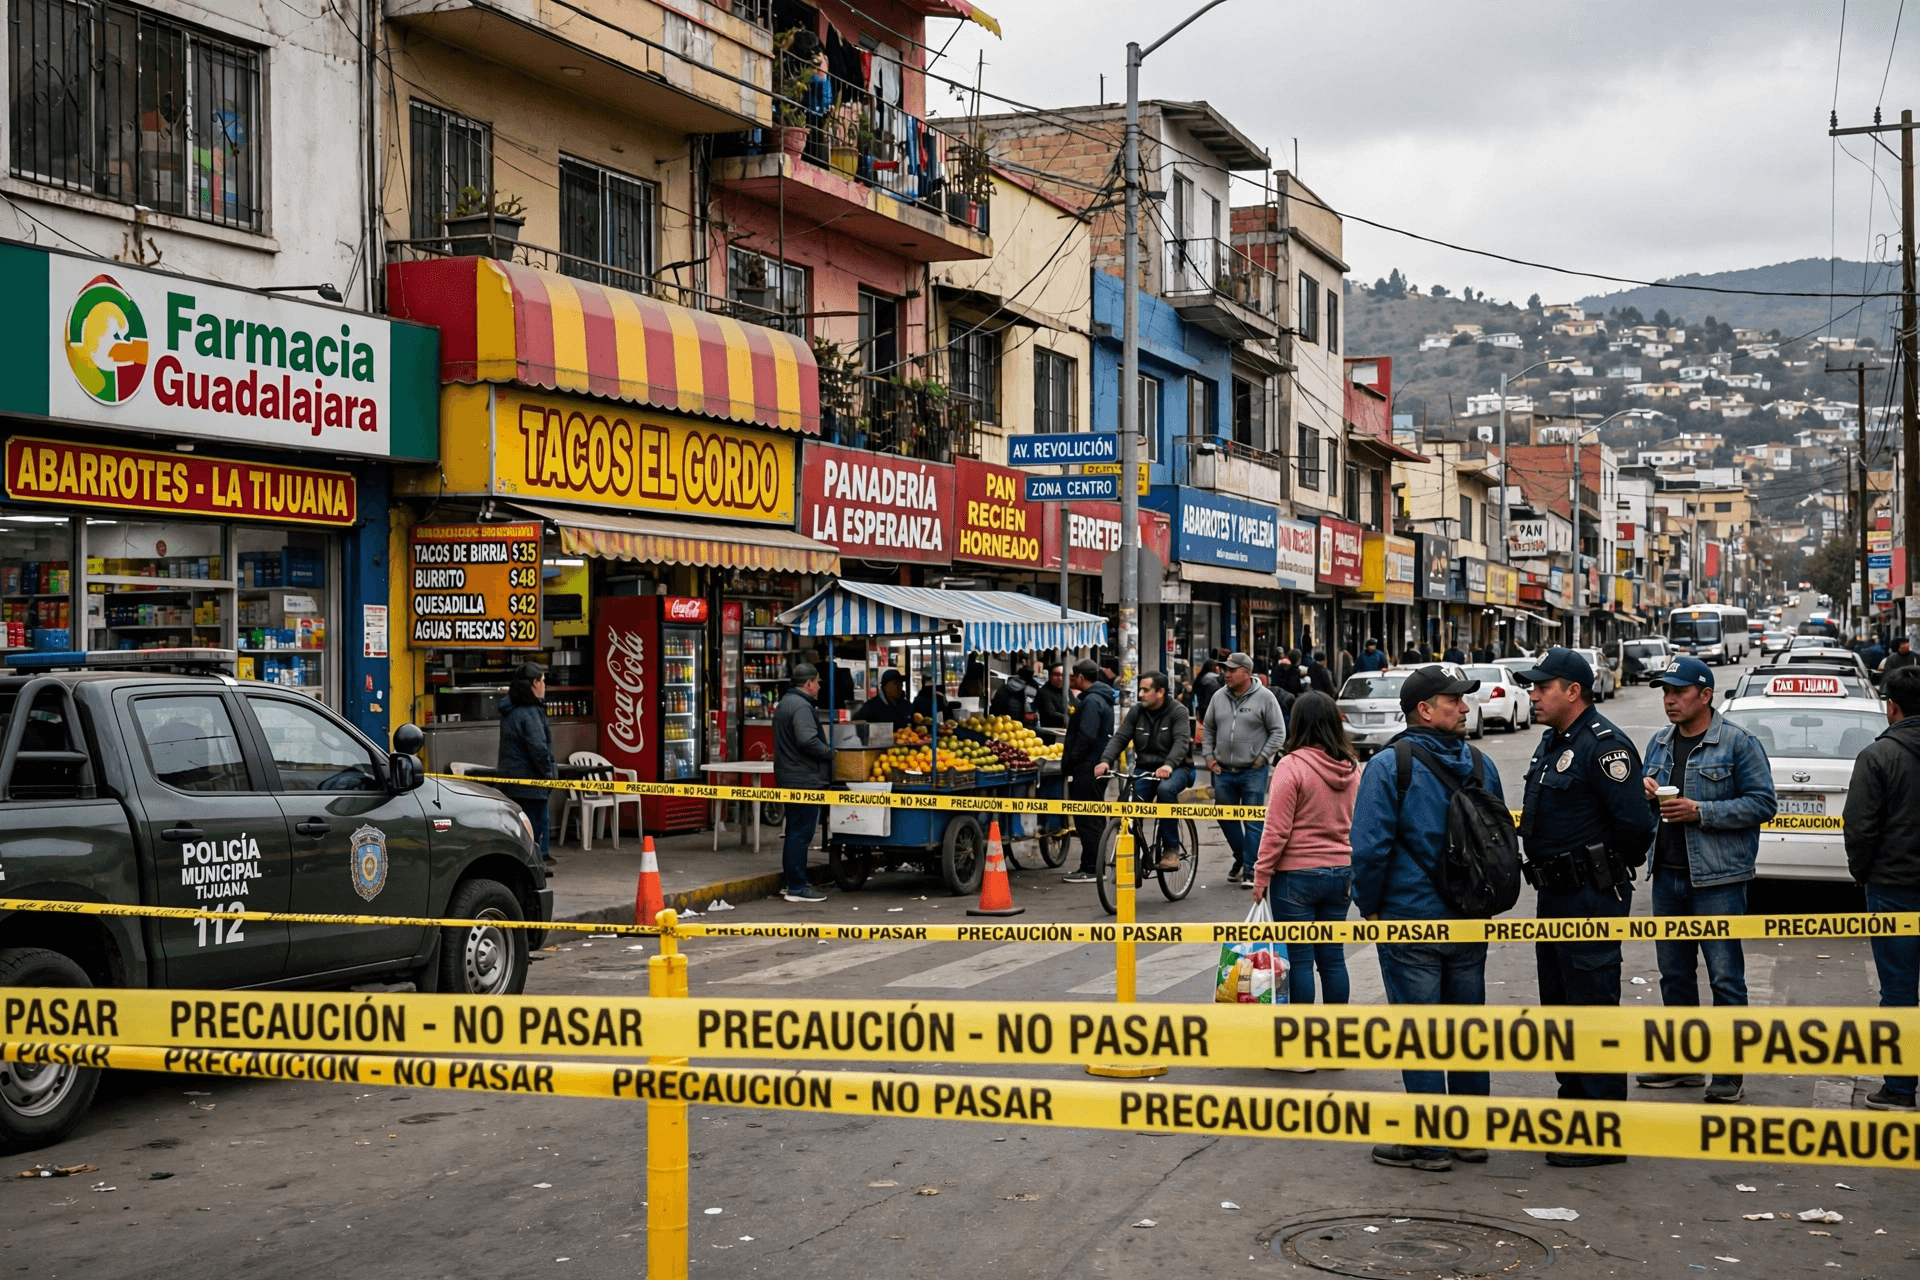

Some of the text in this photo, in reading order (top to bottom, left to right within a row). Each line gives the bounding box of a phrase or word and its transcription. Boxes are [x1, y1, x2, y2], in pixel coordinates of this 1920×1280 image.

[166, 291, 375, 383] Farmacia
[153, 354, 378, 436] Guadalajara
[520, 404, 779, 512] TACOS EL GORDO
[1012, 436, 1114, 459] AV. REVOLUCIÓN
[17, 446, 189, 503] ABARROTES
[211, 466, 243, 507] LA
[249, 471, 348, 517] TIJUANA
[823, 459, 937, 511] PANADERÍA
[986, 472, 1016, 501] PAN
[1031, 480, 1112, 497] ZONA CENTRO
[813, 504, 943, 552] LA ESPERANZA
[967, 499, 1026, 533] RECIÉN
[1068, 513, 1142, 552] ERRETE
[1182, 504, 1230, 542] ABARROTES
[415, 543, 536, 562] TACOS DE BIRRIA $35
[960, 529, 1039, 562] HORNEADO
[415, 568, 536, 588] BURRITO $48
[415, 595, 536, 616] QUESADILLA $42
[415, 620, 536, 640] AGUAS FRESCAS $20
[1768, 816, 1841, 829] PRECAUCIÓN
[182, 832, 261, 865] POLICÍA
[181, 861, 262, 885] MUNICIPAL
[195, 881, 249, 899] TIJUANA
[193, 901, 245, 947] 112
[838, 927, 863, 939] NO
[869, 927, 927, 940] PASAR
[957, 923, 1072, 942] PRECAUCIÓN
[1090, 926, 1116, 941] NO
[1123, 926, 1182, 942] PASAR
[1213, 922, 1333, 942] PRECAUCIÓN
[1353, 925, 1379, 941] NO
[1387, 924, 1449, 941] PASAR
[1484, 918, 1609, 940] PRECAUCIÓN
[1630, 921, 1657, 938] NO
[1665, 920, 1730, 937] PASAR
[1765, 913, 1896, 936] PRECAUCIÓN
[5, 998, 118, 1037] PASAR
[171, 996, 642, 1047] PRECAUCIÓN - NO PASAR
[699, 1003, 1209, 1057] PRECAUCIÓN - NO PASAR
[1273, 1009, 1902, 1066] PRECAUCIÓN - NO PASAR
[17, 1043, 111, 1067] PASAR
[394, 1058, 437, 1087] NO
[449, 1062, 554, 1094] PASAR
[612, 1067, 832, 1109] PRECAUCIÓN
[872, 1081, 920, 1114] NO
[934, 1084, 1053, 1121] PASAR
[1120, 1092, 1370, 1136] PRECAUCIÓN
[1415, 1105, 1469, 1140] NO
[1487, 1109, 1621, 1148] PASAR
